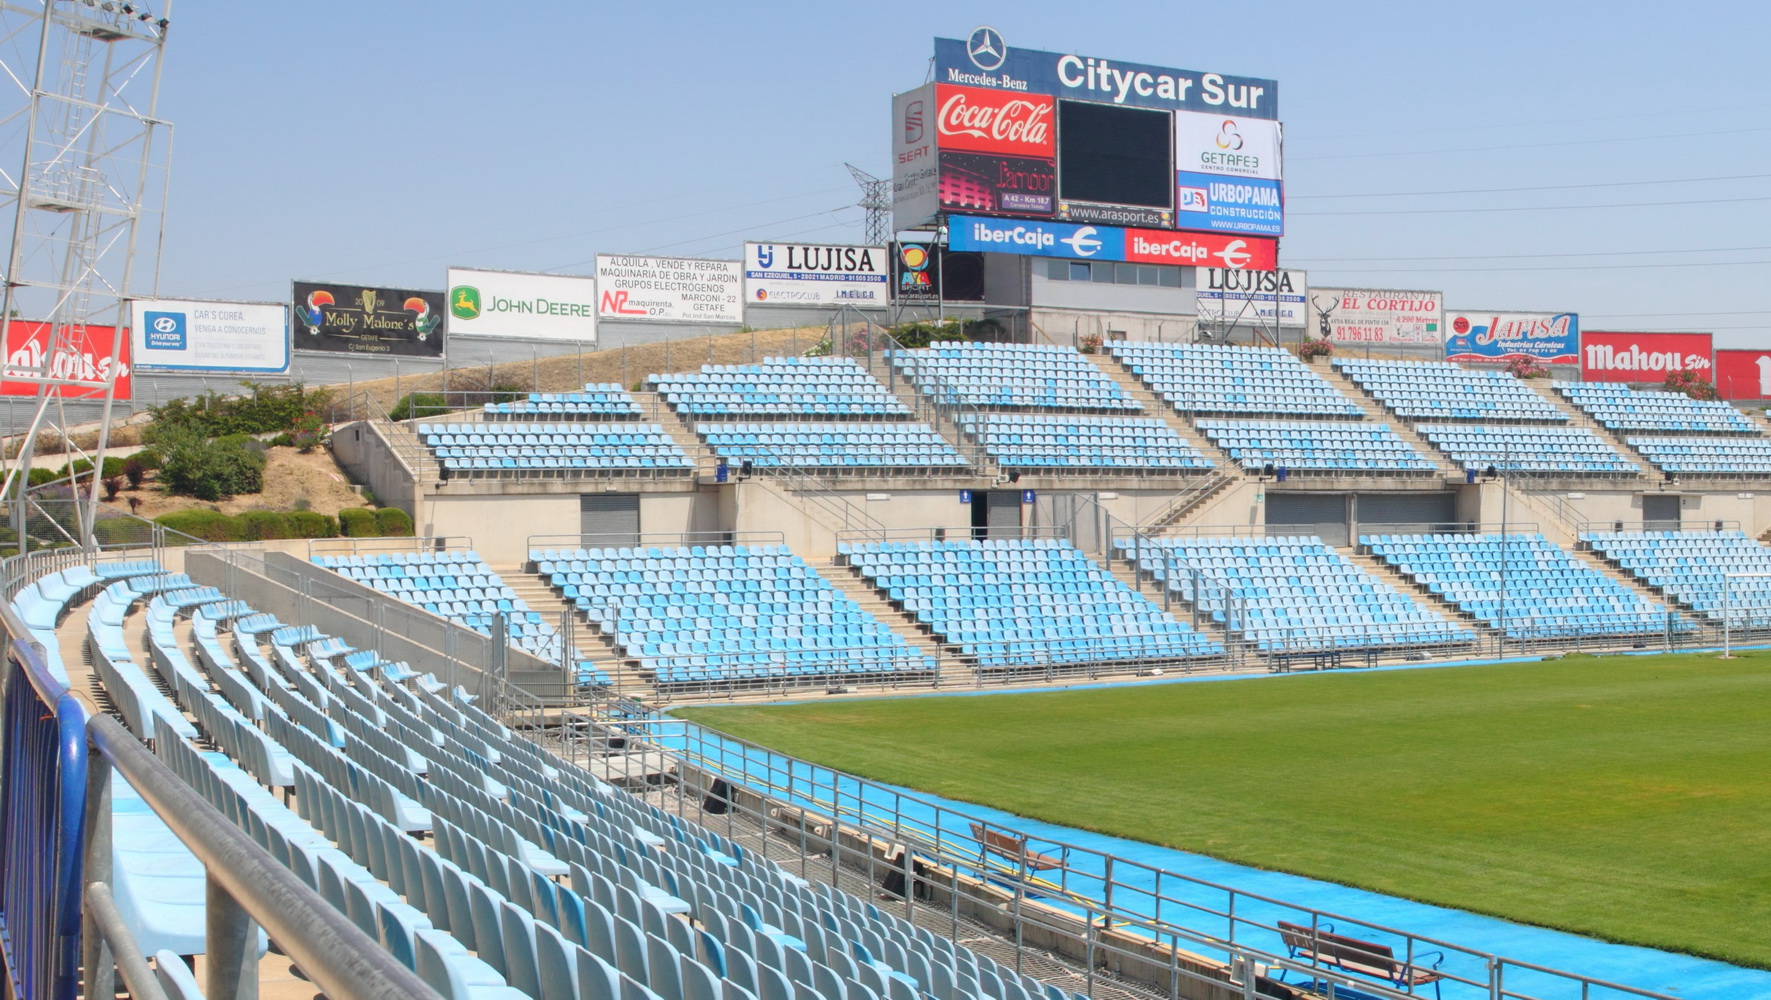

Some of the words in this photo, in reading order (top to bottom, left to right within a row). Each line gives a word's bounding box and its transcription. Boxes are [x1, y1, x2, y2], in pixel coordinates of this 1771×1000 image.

[948, 68, 1028, 90] Mercedes-Benz
[1057, 54, 1192, 104] Citycar
[1202, 73, 1264, 109] Sur
[937, 94, 1053, 144] Coca-Cola
[898, 146, 930, 164] SEAT
[1210, 182, 1280, 207] URBOPAMA
[1070, 206, 1159, 224] www.arasport.es
[1210, 206, 1281, 220] CONSTRUCCIÓN
[1211, 220, 1280, 232] WWW.URBOPAMA.ES
[974, 223, 1054, 250] iberCaja
[1134, 236, 1208, 262] iberCaja
[610, 257, 649, 268] ALQUILA
[656, 259, 685, 270] VENDE
[686, 261, 693, 271] Y
[694, 261, 728, 272] REPARA
[787, 246, 875, 272] LUJISA
[600, 268, 657, 280] MAQUINARIA
[658, 270, 671, 281] DE
[672, 272, 695, 282] OBRA
[696, 272, 704, 282] Y
[706, 272, 738, 283] JARDIN
[1208, 268, 1294, 293] LUJISA
[615, 280, 652, 290] GRUPOS
[681, 293, 721, 303] MARCONI
[1342, 290, 1436, 300] RESTAURANTE
[487, 296, 533, 314] JOHN
[536, 299, 591, 318] DEERE
[693, 303, 725, 312] GETAFE
[1342, 298, 1360, 310] EL
[1366, 298, 1436, 312] CORTIJO
[194, 325, 216, 334] VENGA
[326, 312, 358, 332] Molly
[151, 333, 180, 341] HYUNDAI
[361, 334, 379, 342] GETAFE
[1337, 326, 1346, 340] 91
[1348, 326, 1362, 341] 796
[1364, 327, 1372, 341] 11
[1374, 328, 1384, 342] 83
[366, 344, 386, 352] Eugenio
[1497, 340, 1534, 348] Industrias
[1534, 341, 1566, 349] Cárnicas
[1585, 344, 1683, 371] Mahou
[1685, 354, 1711, 371] Sin
